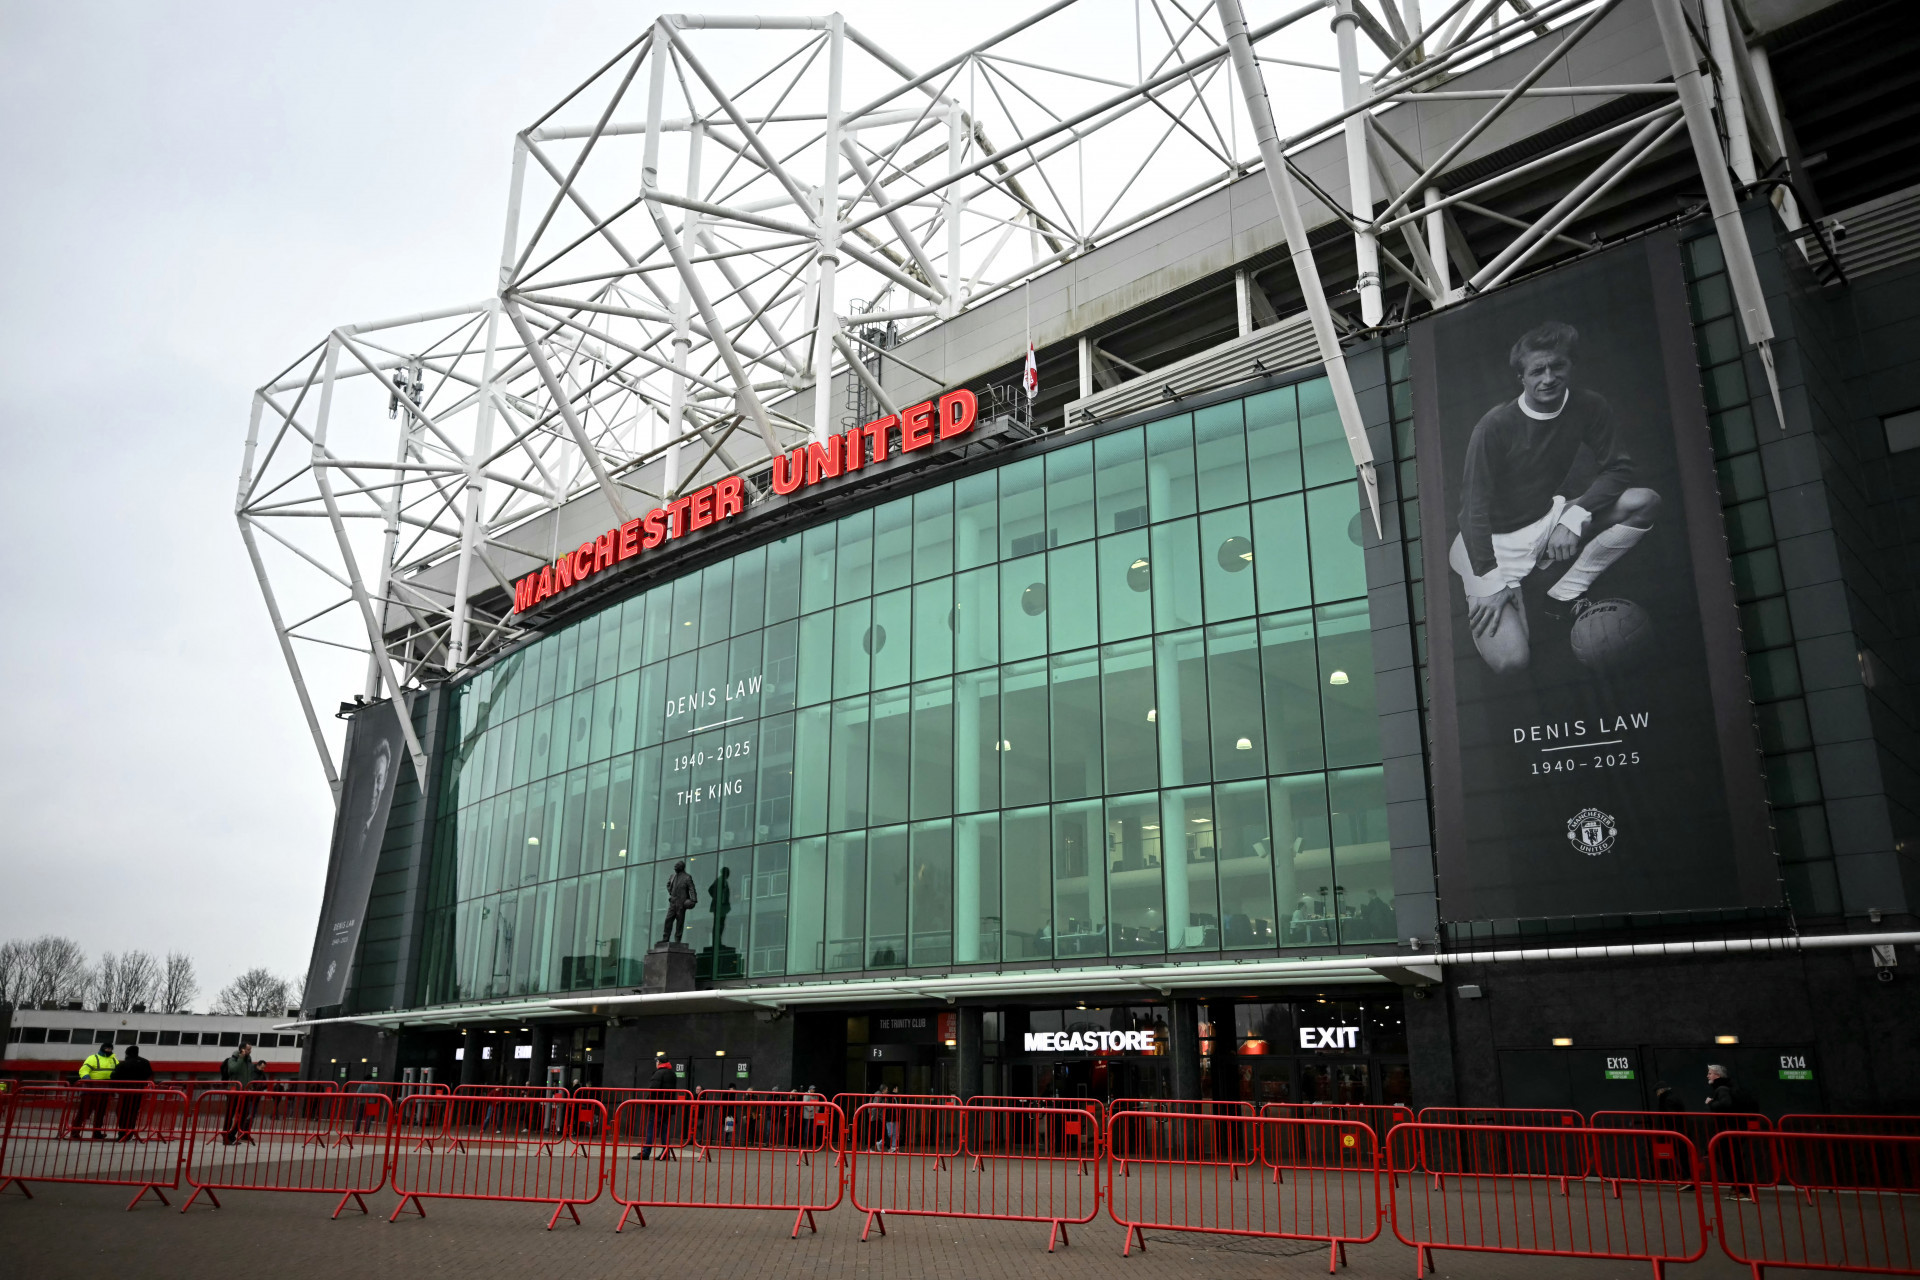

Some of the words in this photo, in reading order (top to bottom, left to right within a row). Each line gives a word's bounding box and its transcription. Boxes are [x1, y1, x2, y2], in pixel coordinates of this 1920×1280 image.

[512, 475, 745, 615] MANCHESTER
[772, 388, 979, 496] UNITED
[666, 688, 717, 718] DENIS
[725, 674, 762, 701] LAW
[1513, 720, 1586, 744] DENIS
[1599, 711, 1649, 733] LAW
[677, 787, 702, 806] THE
[708, 779, 743, 800] KING
[1571, 811, 1611, 829] MANCHESTER
[1579, 843, 1608, 853] UNITED
[880, 1019, 890, 1029] THE
[890, 1018, 911, 1029] TRINITY
[912, 1018, 926, 1028] CLUB
[1024, 1030, 1156, 1052] MEGASTORE
[1300, 1026, 1360, 1049] EXIT
[1606, 1057, 1629, 1069] EX13
[1780, 1055, 1806, 1069] EX14
